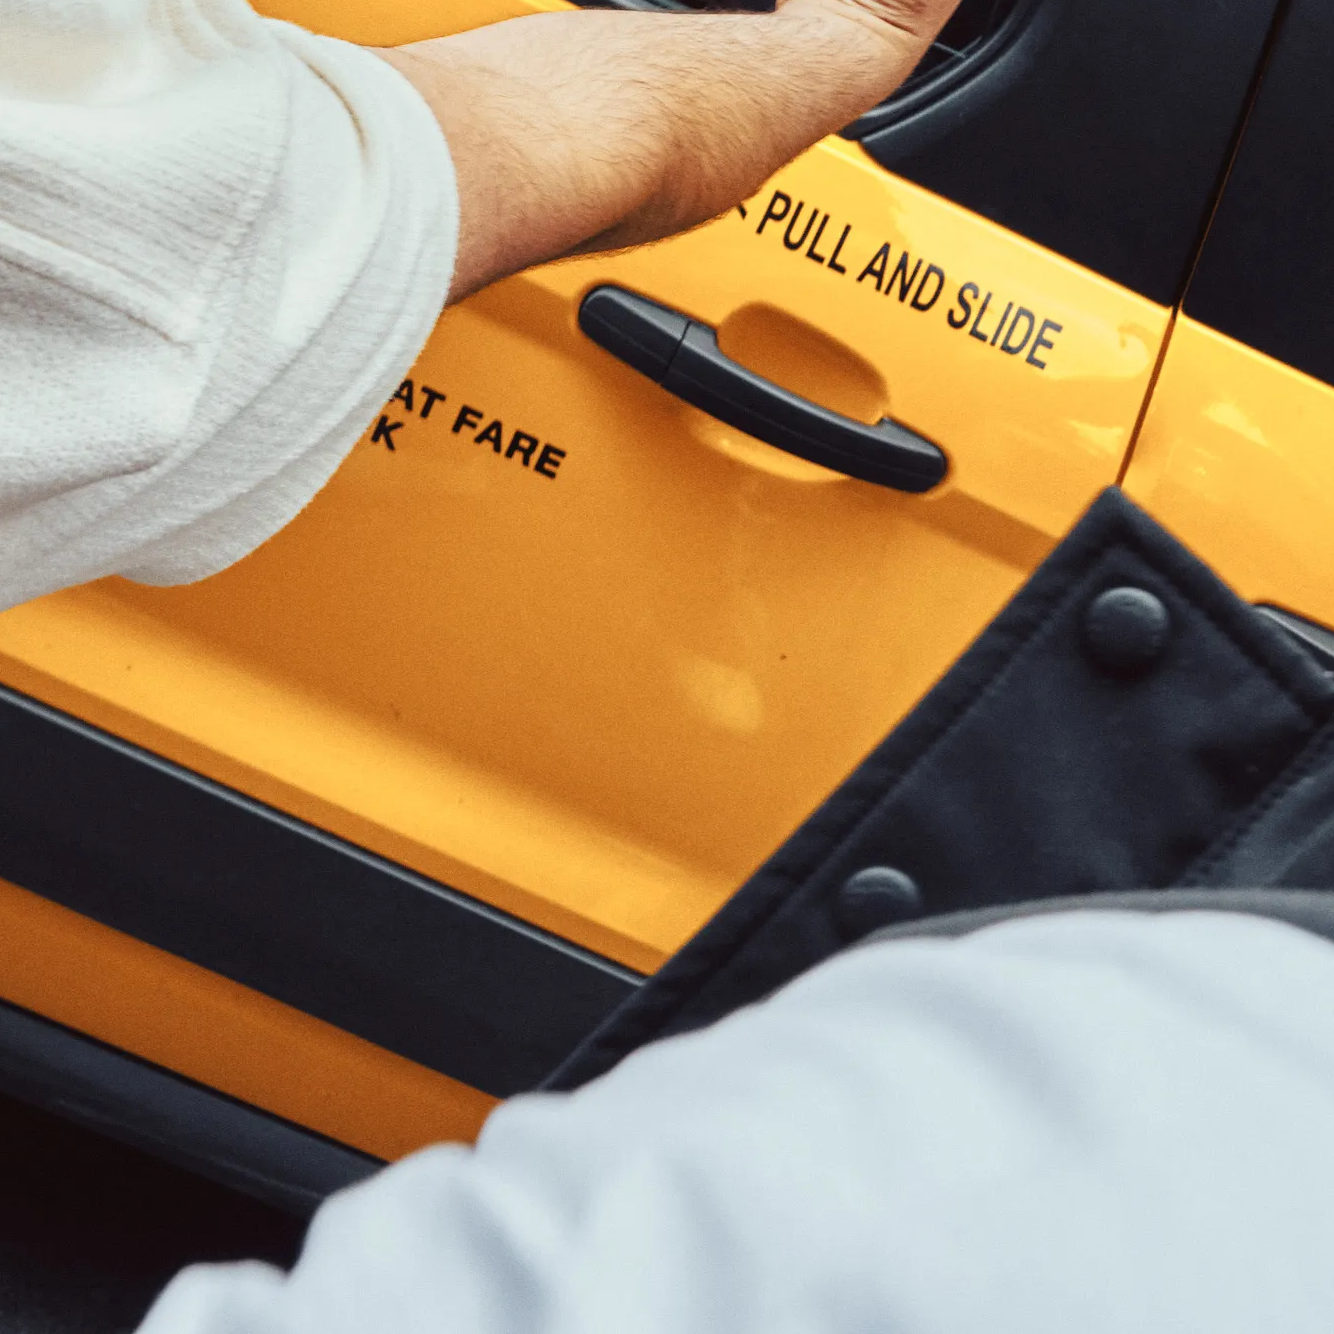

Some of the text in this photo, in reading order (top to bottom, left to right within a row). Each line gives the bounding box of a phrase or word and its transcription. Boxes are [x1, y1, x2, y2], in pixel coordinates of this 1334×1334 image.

[755, 189, 1063, 370] PULL AND SLIDE
[451, 404, 567, 480] FARE
